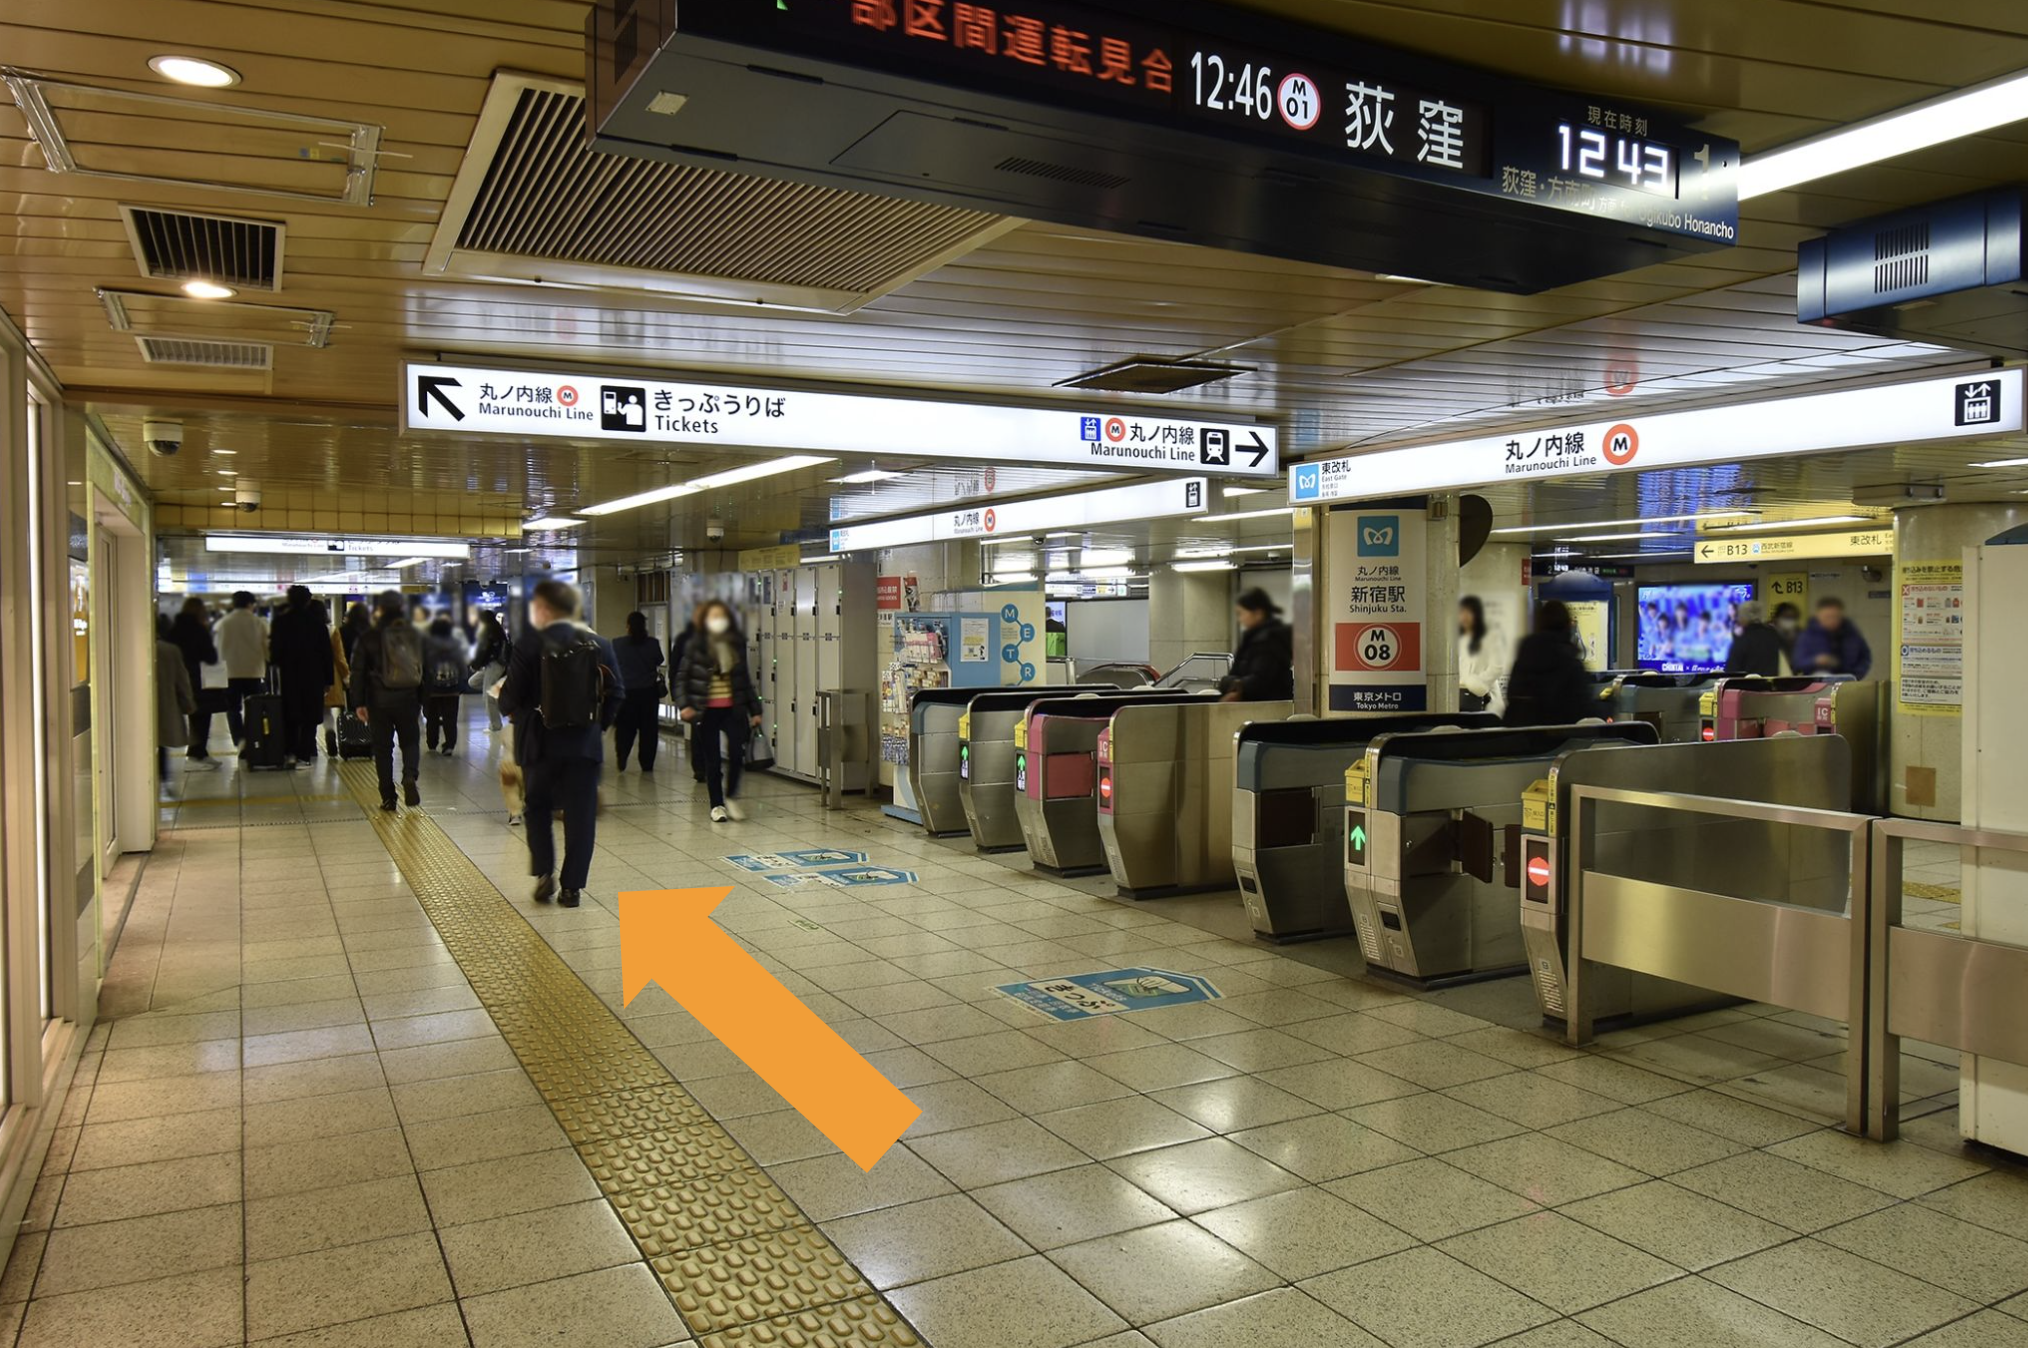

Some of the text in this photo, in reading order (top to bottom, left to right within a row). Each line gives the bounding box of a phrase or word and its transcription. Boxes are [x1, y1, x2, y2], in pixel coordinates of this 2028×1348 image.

[1191, 51, 1273, 120] 12:46
[1292, 79, 1307, 97] M
[1286, 97, 1309, 120] 01
[1345, 81, 1464, 170] 荻窪
[1587, 105, 1649, 137] 現在時刻
[1684, 213, 1735, 240] Honancho
[479, 383, 553, 404] 丸ノ内線
[562, 390, 573, 401] M
[478, 403, 594, 421] Marunouchi Line
[653, 389, 787, 418] きっぷうりば
[655, 415, 719, 434] Tickets
[1130, 423, 1195, 446] 丸ノ内線
[1090, 442, 1195, 462] Marunouchi Line
[1505, 432, 1585, 462] 丸ノ内線
[1612, 436, 1628, 452] M
[1321, 459, 1352, 475] 東改札
[1505, 454, 1597, 475] Marunouchi Line
[953, 512, 980, 527] 丸ノ内線
[1726, 543, 1748, 556] B13
[1850, 534, 1882, 547] 東改札
[1357, 565, 1399, 577] 丸ノ内線
[1351, 585, 1405, 604] 新宿駅
[1786, 581, 1803, 594] B13
[1349, 604, 1407, 615] Shinjuku Sta.
[1370, 629, 1386, 642] M
[1364, 644, 1391, 661] 08
[1353, 691, 1402, 701] 東京メトロ
[1356, 702, 1399, 711] Tokyo Metro
[1817, 707, 1829, 716] IC
